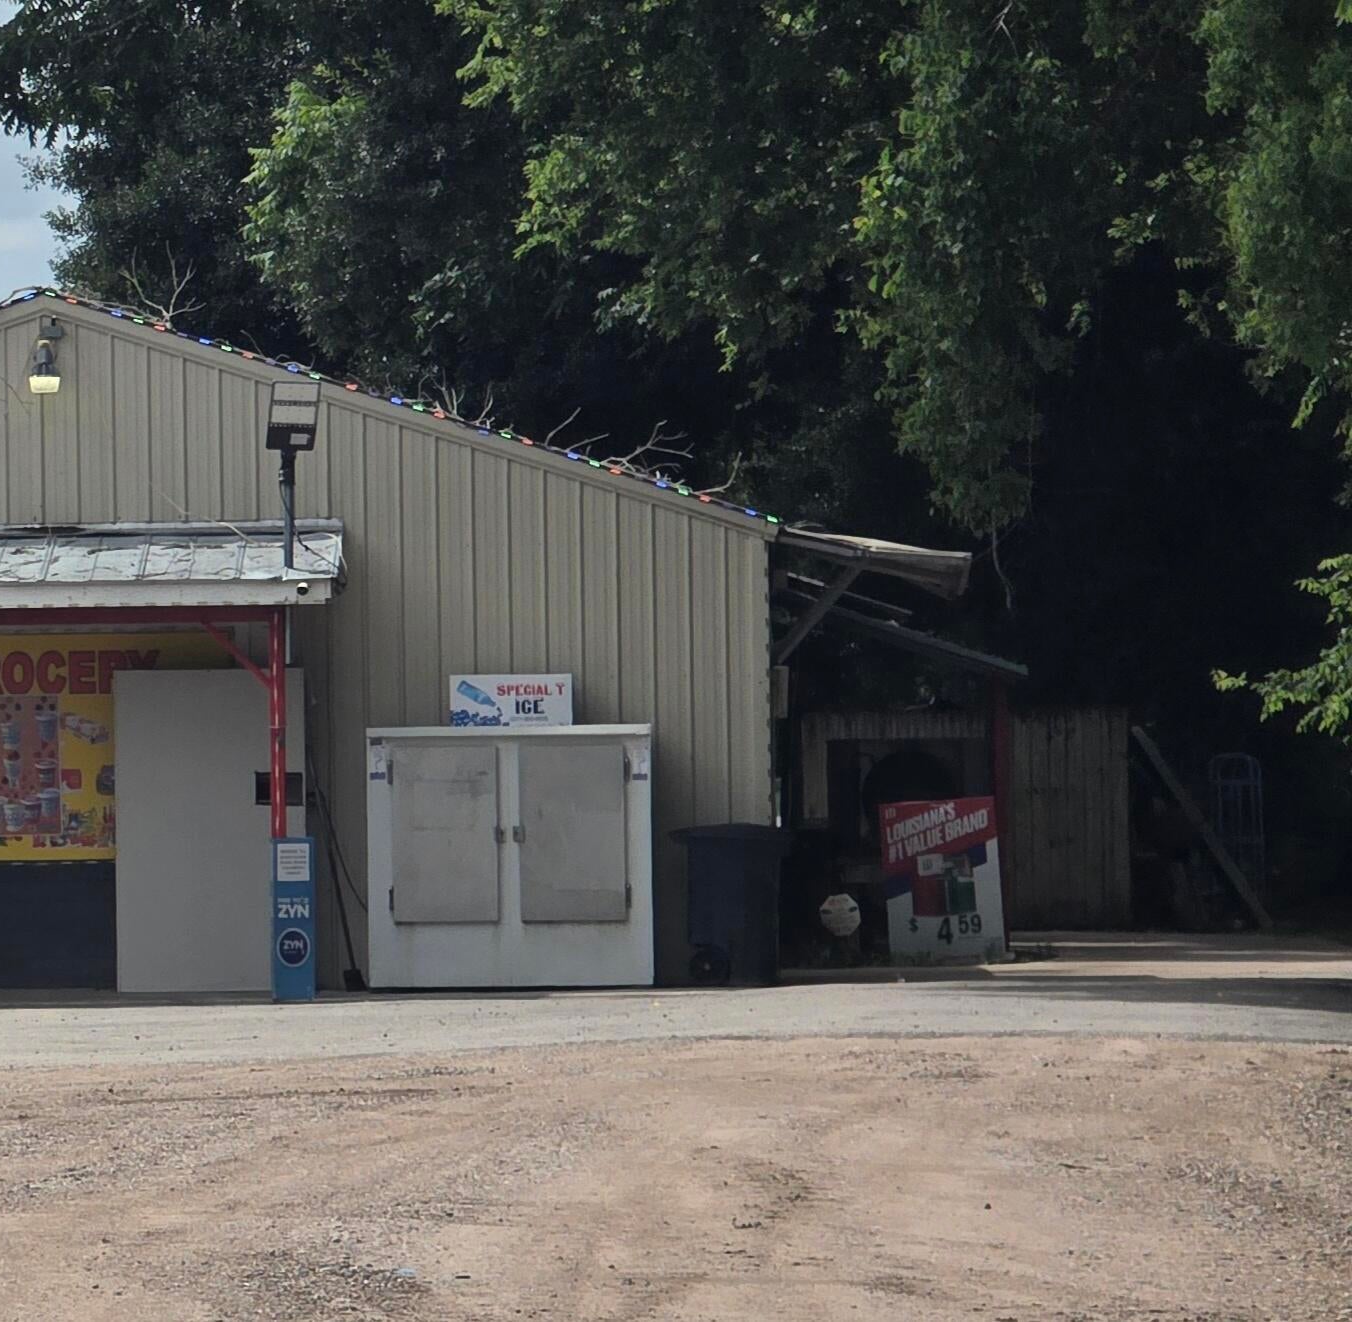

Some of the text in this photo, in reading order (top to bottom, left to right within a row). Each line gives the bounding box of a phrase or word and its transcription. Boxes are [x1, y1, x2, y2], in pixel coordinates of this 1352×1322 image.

[496, 682, 565, 697] SPECIAL T
[515, 697, 545, 714] ICE
[886, 801, 956, 845] LOUISIANA'S
[888, 808, 989, 864] #1 VALUE BRAND
[277, 904, 310, 919] ZYN
[938, 917, 954, 945] 4
[959, 914, 982, 934] 59
[283, 940, 304, 950] ZYN
